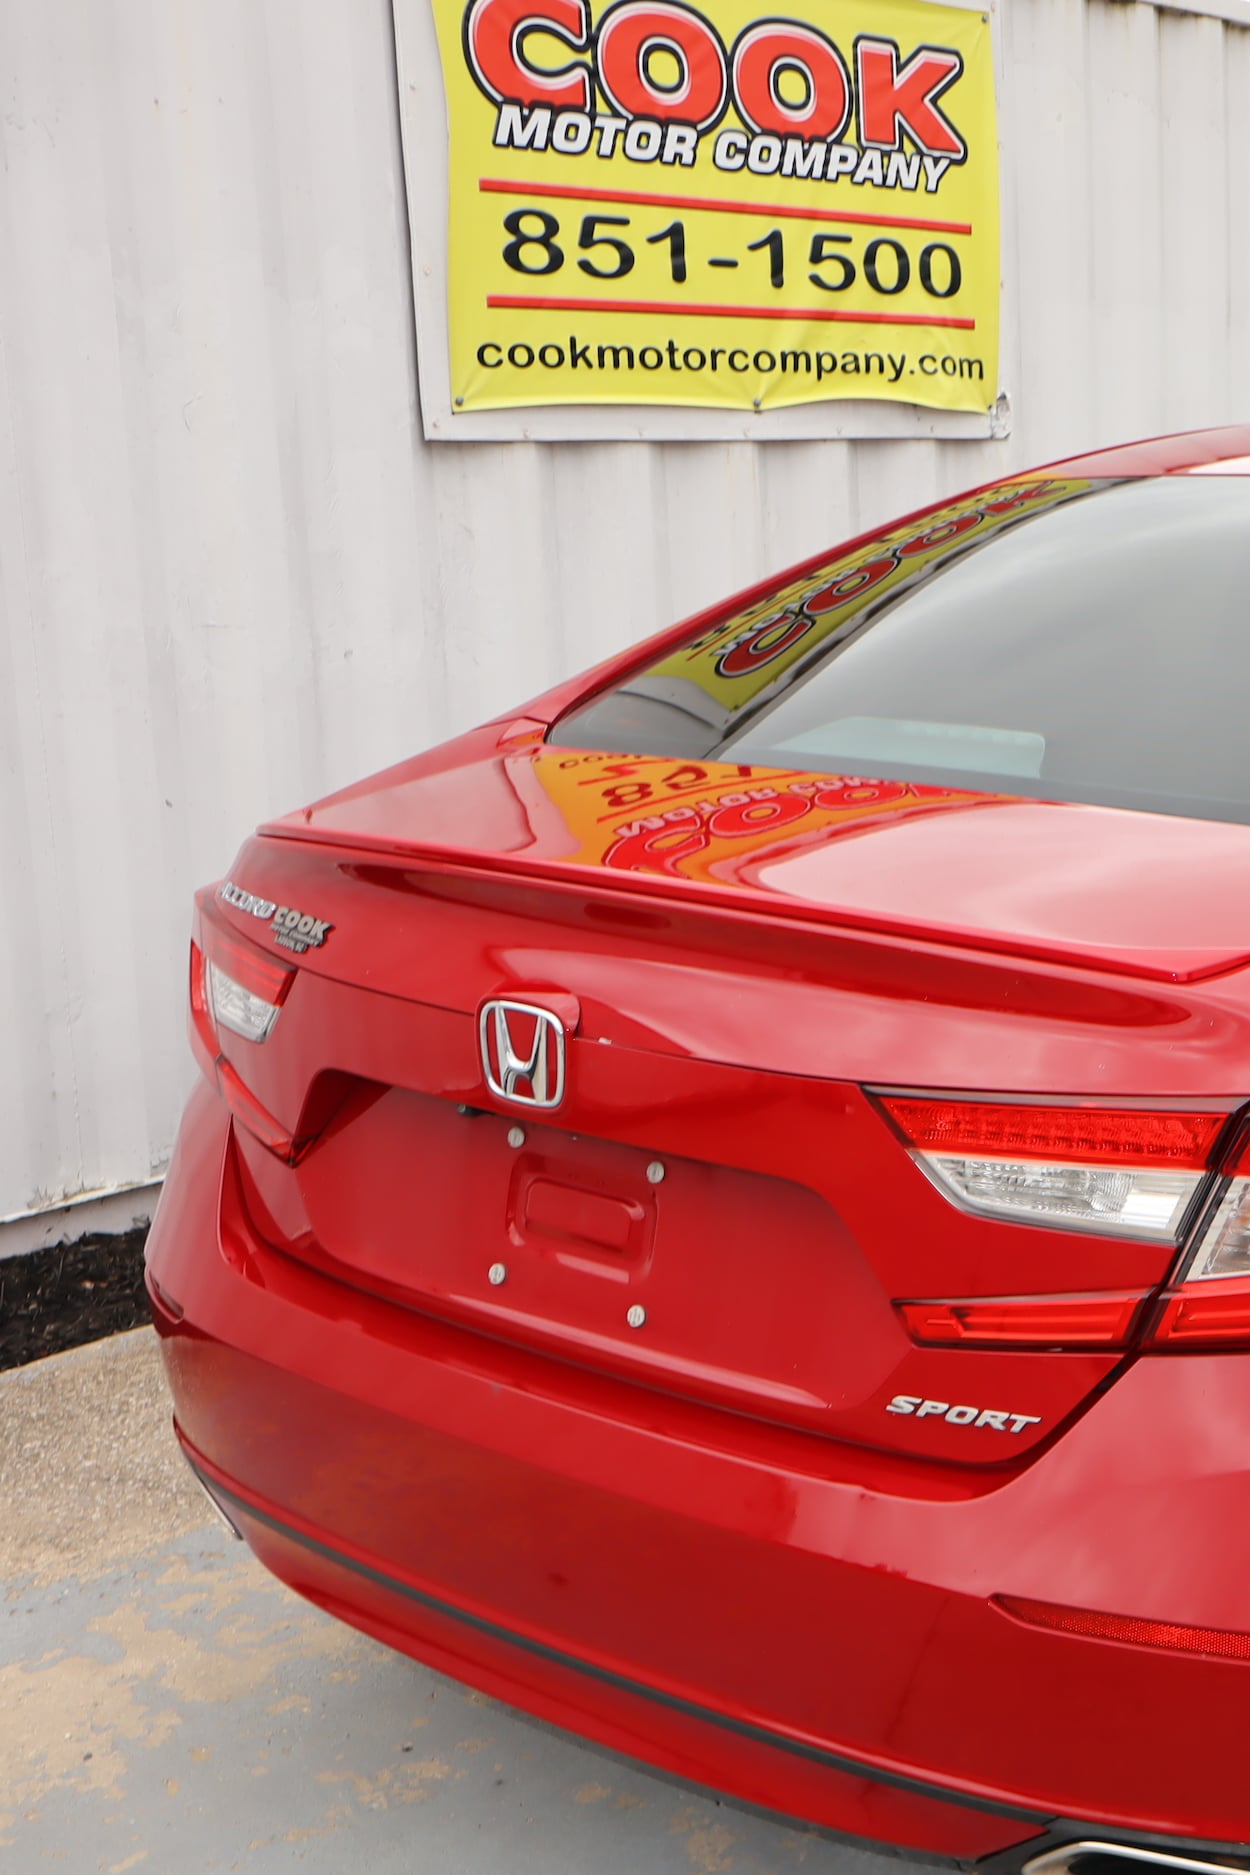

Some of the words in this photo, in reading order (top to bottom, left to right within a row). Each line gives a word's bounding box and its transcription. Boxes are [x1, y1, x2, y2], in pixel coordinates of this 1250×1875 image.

[462, 0, 967, 162] COOK
[494, 102, 698, 167] MOTOR
[714, 131, 955, 193] COMPANY
[501, 208, 962, 299] 851-1500
[477, 336, 984, 383] cookmotorcompany.com
[274, 905, 334, 942] COOK
[885, 1395, 1042, 1433] SPORT
